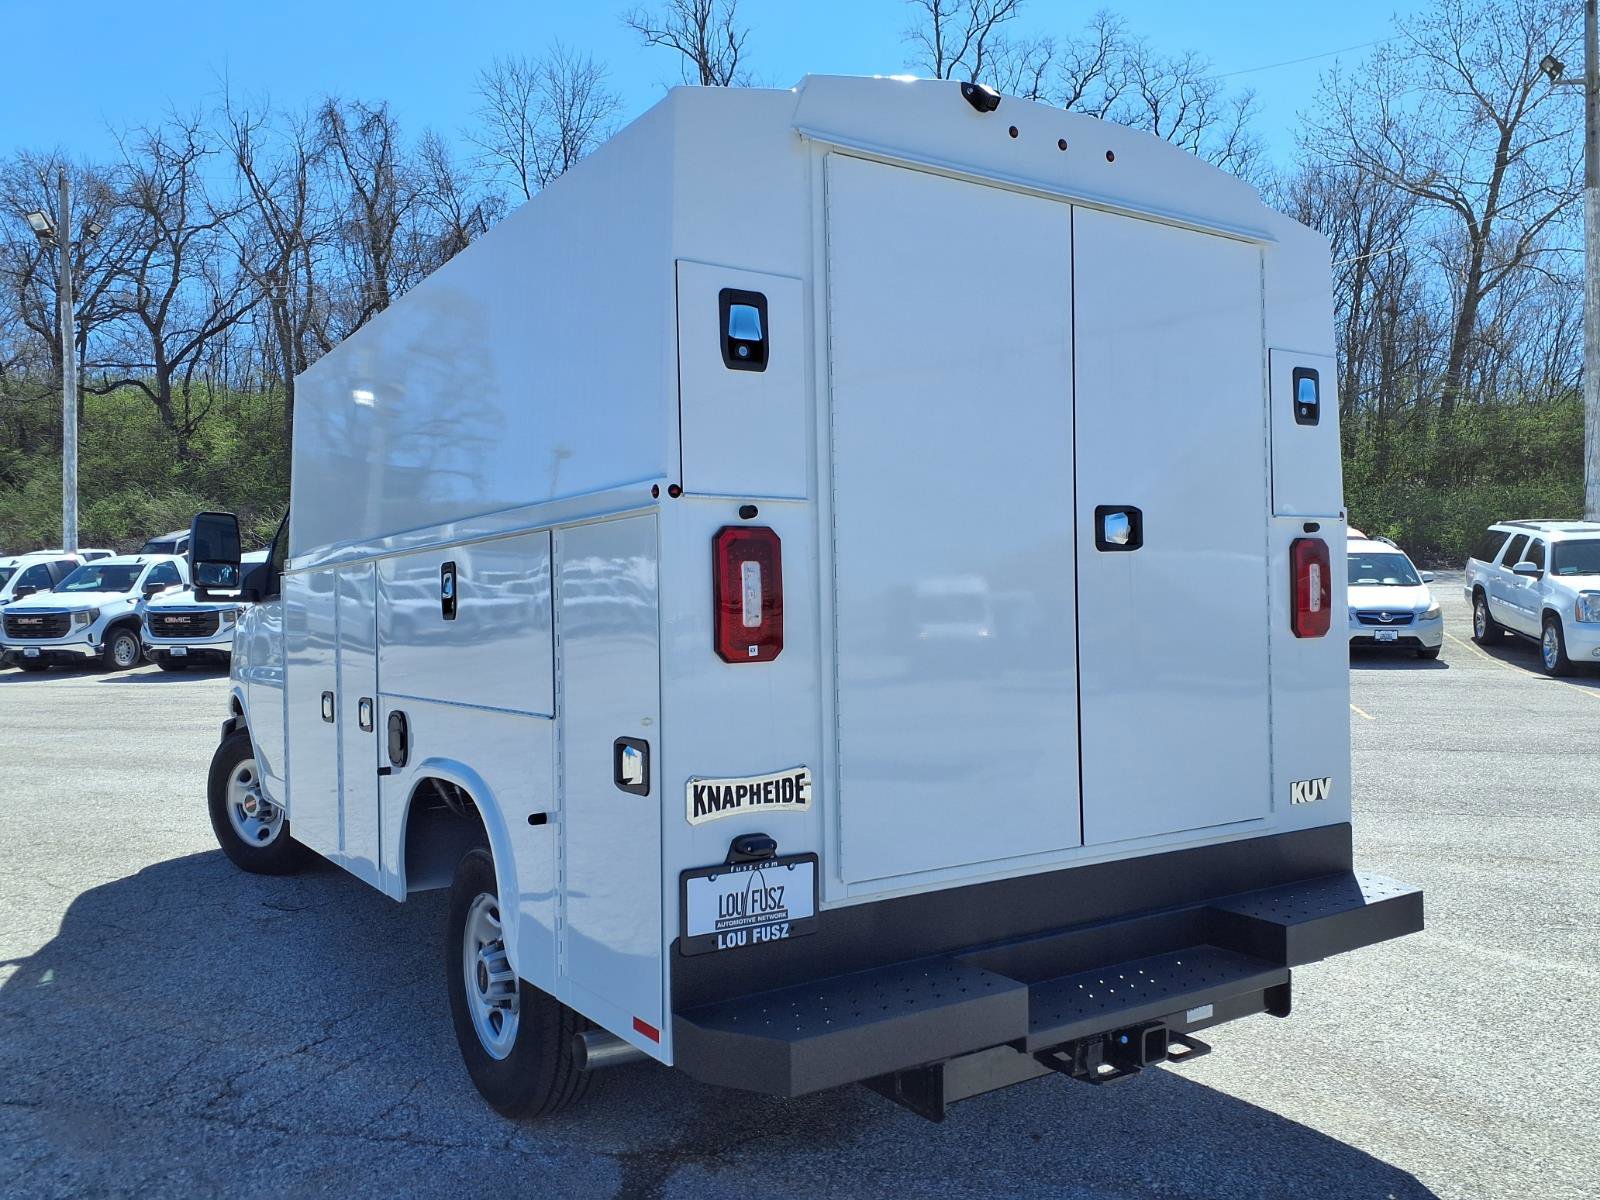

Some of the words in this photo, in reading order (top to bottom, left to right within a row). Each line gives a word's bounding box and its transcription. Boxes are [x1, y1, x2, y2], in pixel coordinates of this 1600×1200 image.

[693, 772, 806, 818] KNAPHEIDE
[1290, 776, 1333, 805] KUV
[730, 861, 777, 872] fusz.com
[718, 891, 744, 919] LOU
[751, 885, 785, 915] FUSZ
[716, 916, 757, 929] AUTOMOTIVE
[757, 911, 788, 922] NETWORK
[717, 929, 747, 950] LOU
[752, 923, 790, 944] FUSZ
